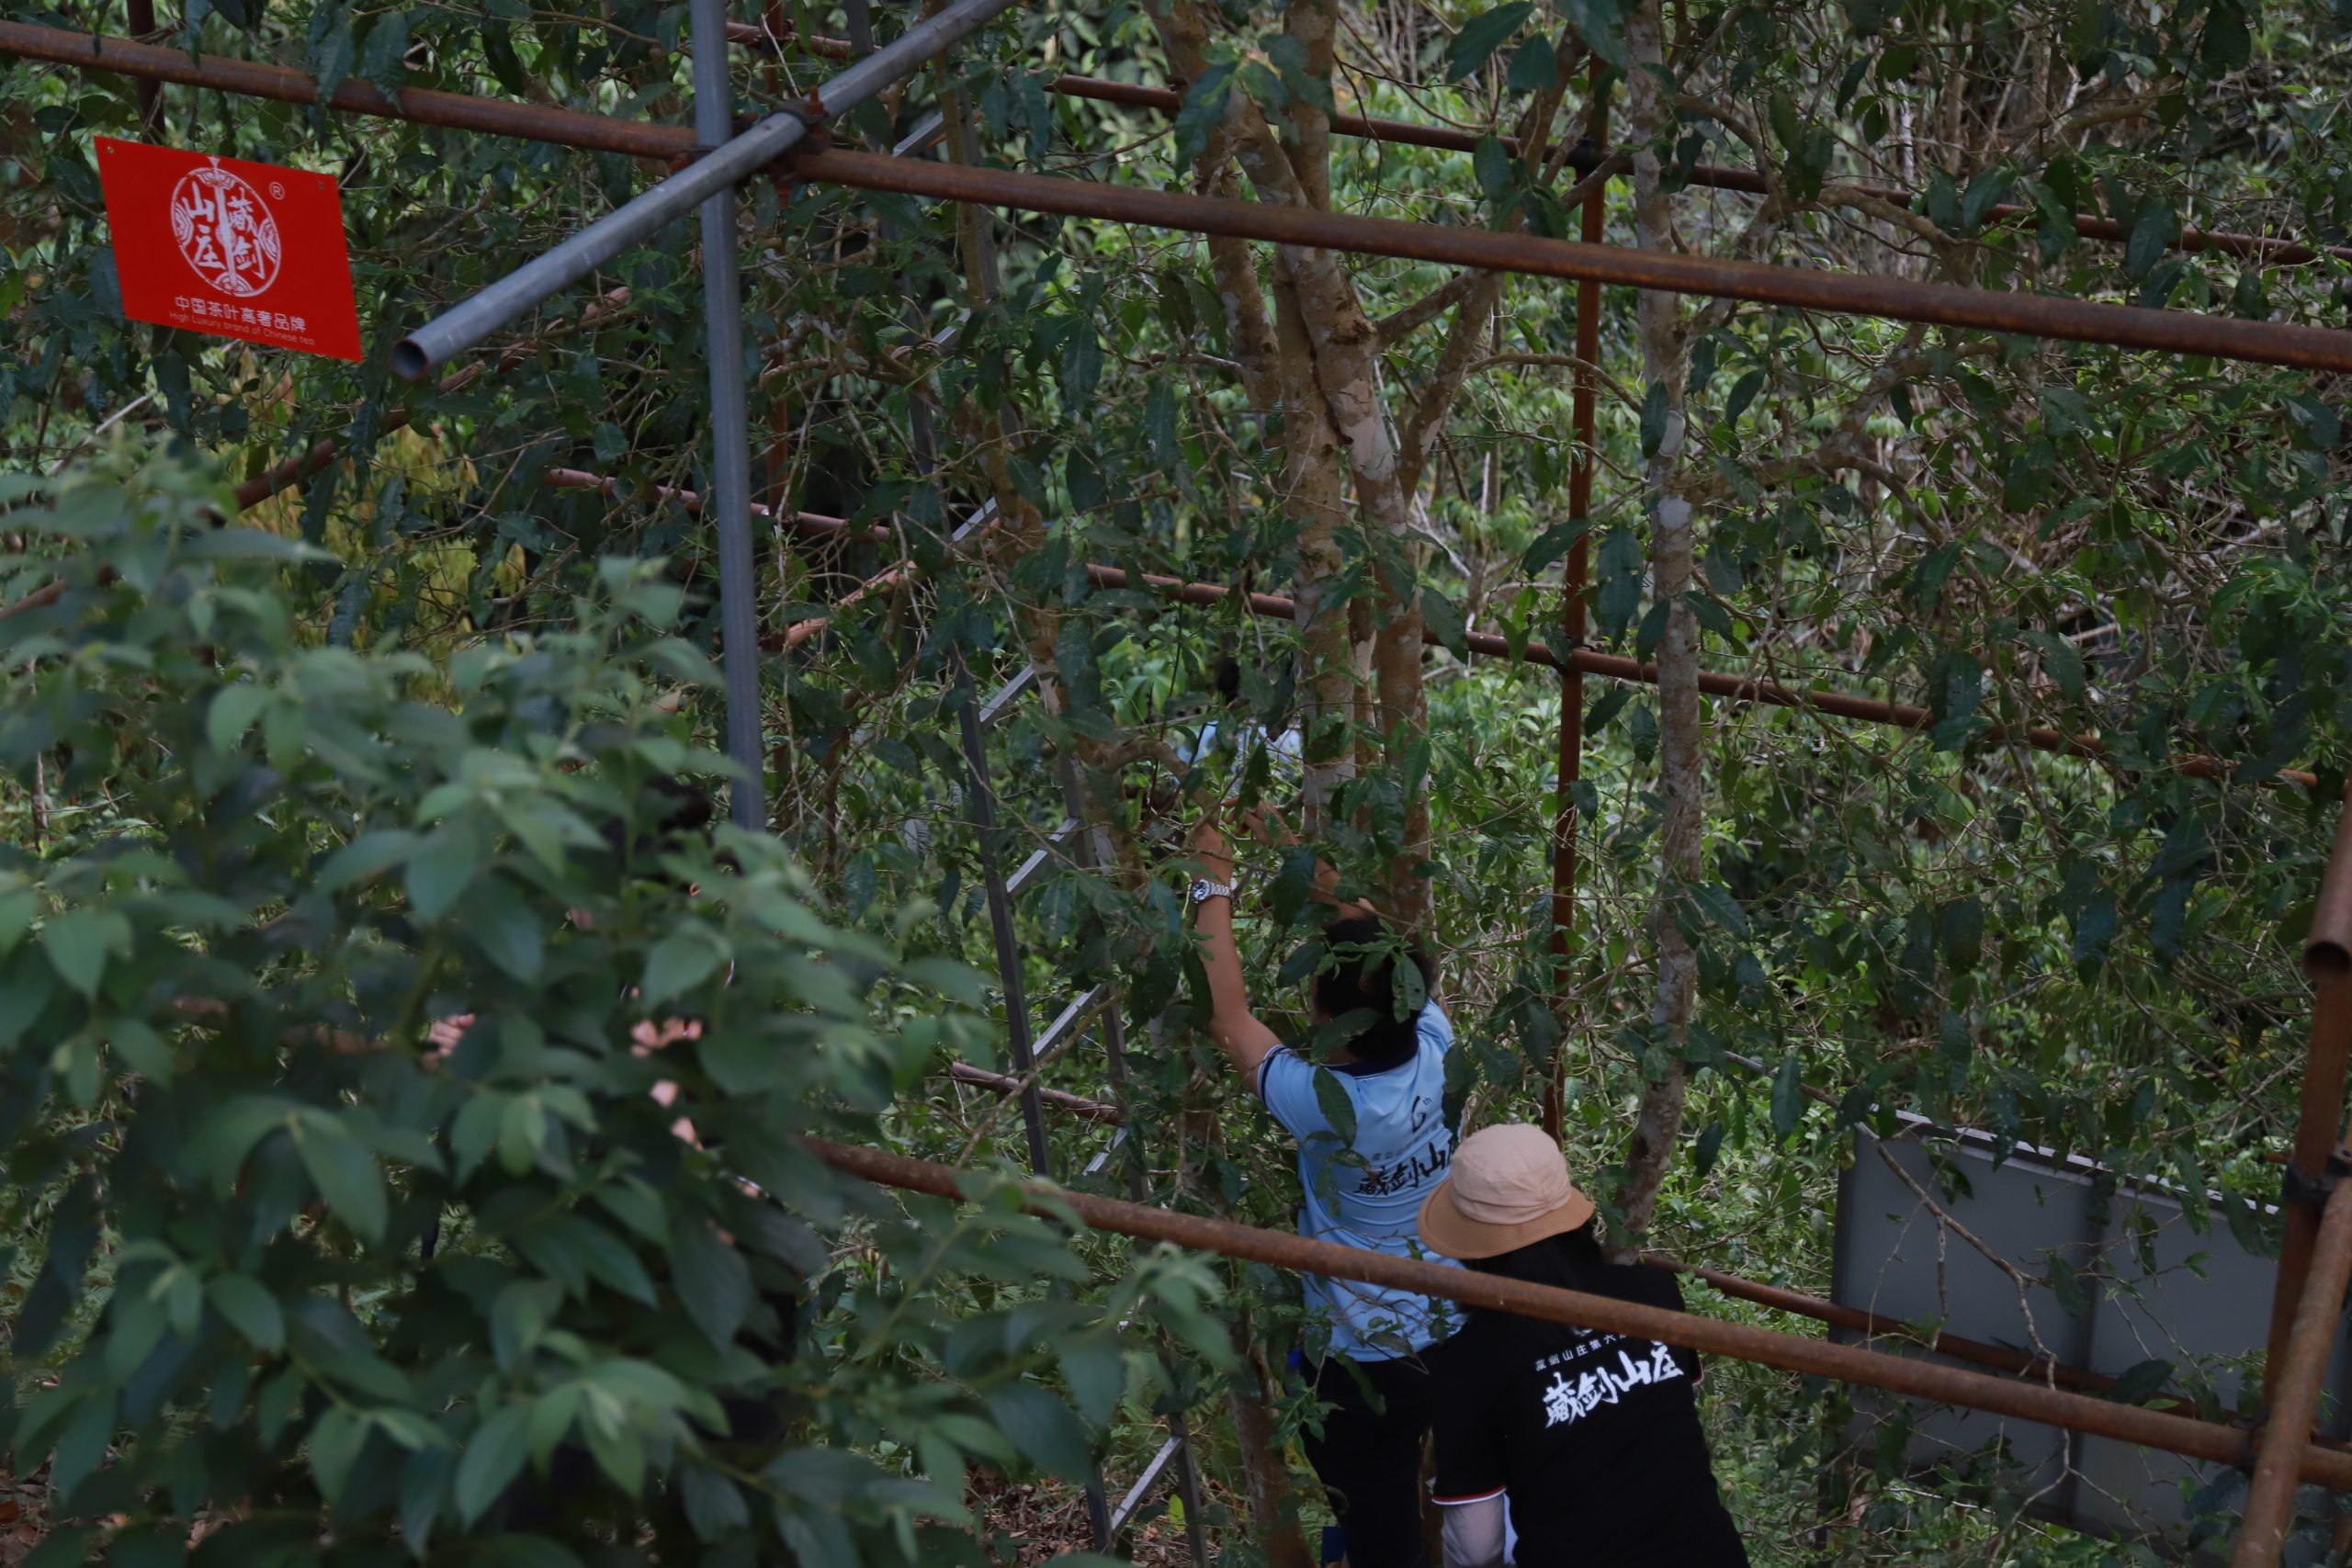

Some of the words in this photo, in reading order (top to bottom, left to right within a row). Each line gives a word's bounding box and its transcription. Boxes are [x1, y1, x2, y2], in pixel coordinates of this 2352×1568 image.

[169, 310, 190, 323] High
[191, 316, 221, 329] Luxury
[223, 321, 251, 333] brand
[253, 326, 261, 335] of
[264, 328, 299, 343] Chinese
[300, 336, 315, 346] tea
[175, 295, 307, 333] 中国茶叶高奢品牌
[1352, 1139, 1453, 1197] 藏剑山
[1534, 1334, 1627, 1372] 藏剑山庄第六
[1543, 1339, 1684, 1429] 藏剑山庄
